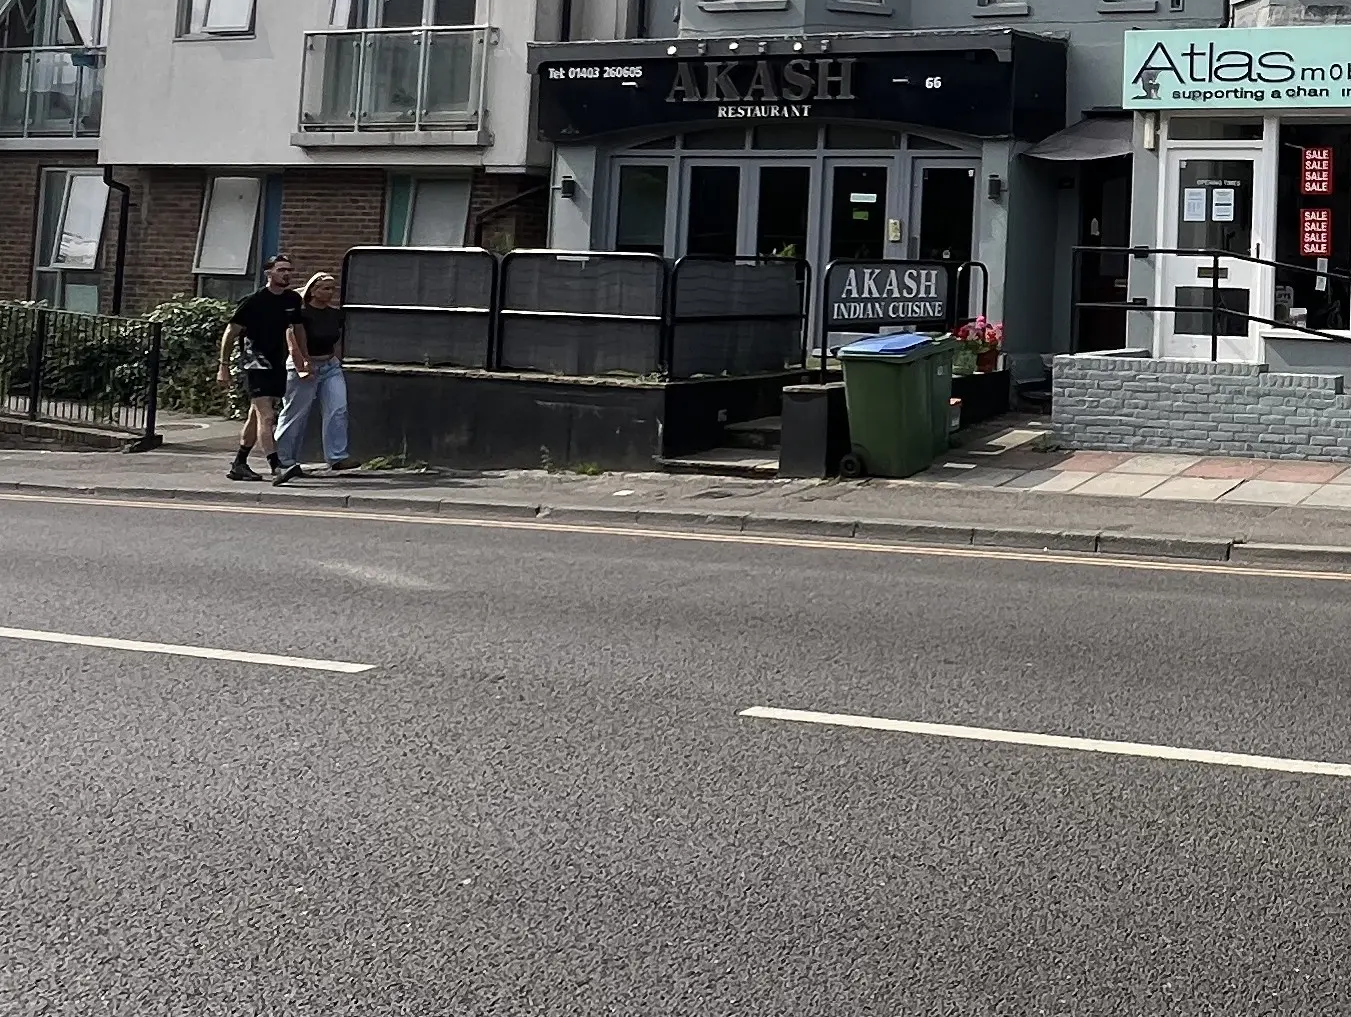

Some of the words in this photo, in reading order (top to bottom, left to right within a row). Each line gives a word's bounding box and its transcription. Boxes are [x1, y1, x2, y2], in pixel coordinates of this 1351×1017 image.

[1131, 41, 1296, 84] Atlas
[568, 67, 599, 79] 01403
[603, 66, 643, 78] 260605
[665, 58, 857, 102] AKASH
[925, 77, 942, 89] 66
[1172, 87, 1265, 101] supporting
[1270, 90, 1281, 99] a
[717, 105, 812, 118] RESTAURANT
[1305, 149, 1329, 160] SALE
[1305, 160, 1329, 170] SALE
[1305, 171, 1329, 181] SALE
[1305, 181, 1329, 192] SALE
[1304, 211, 1328, 221] SALE
[1304, 221, 1328, 232] SALE
[1304, 232, 1328, 243] SALE
[1304, 243, 1328, 253] SALE
[841, 268, 938, 298] AKASH
[833, 302, 885, 319] INDIAN
[888, 301, 943, 318] CUISINE
